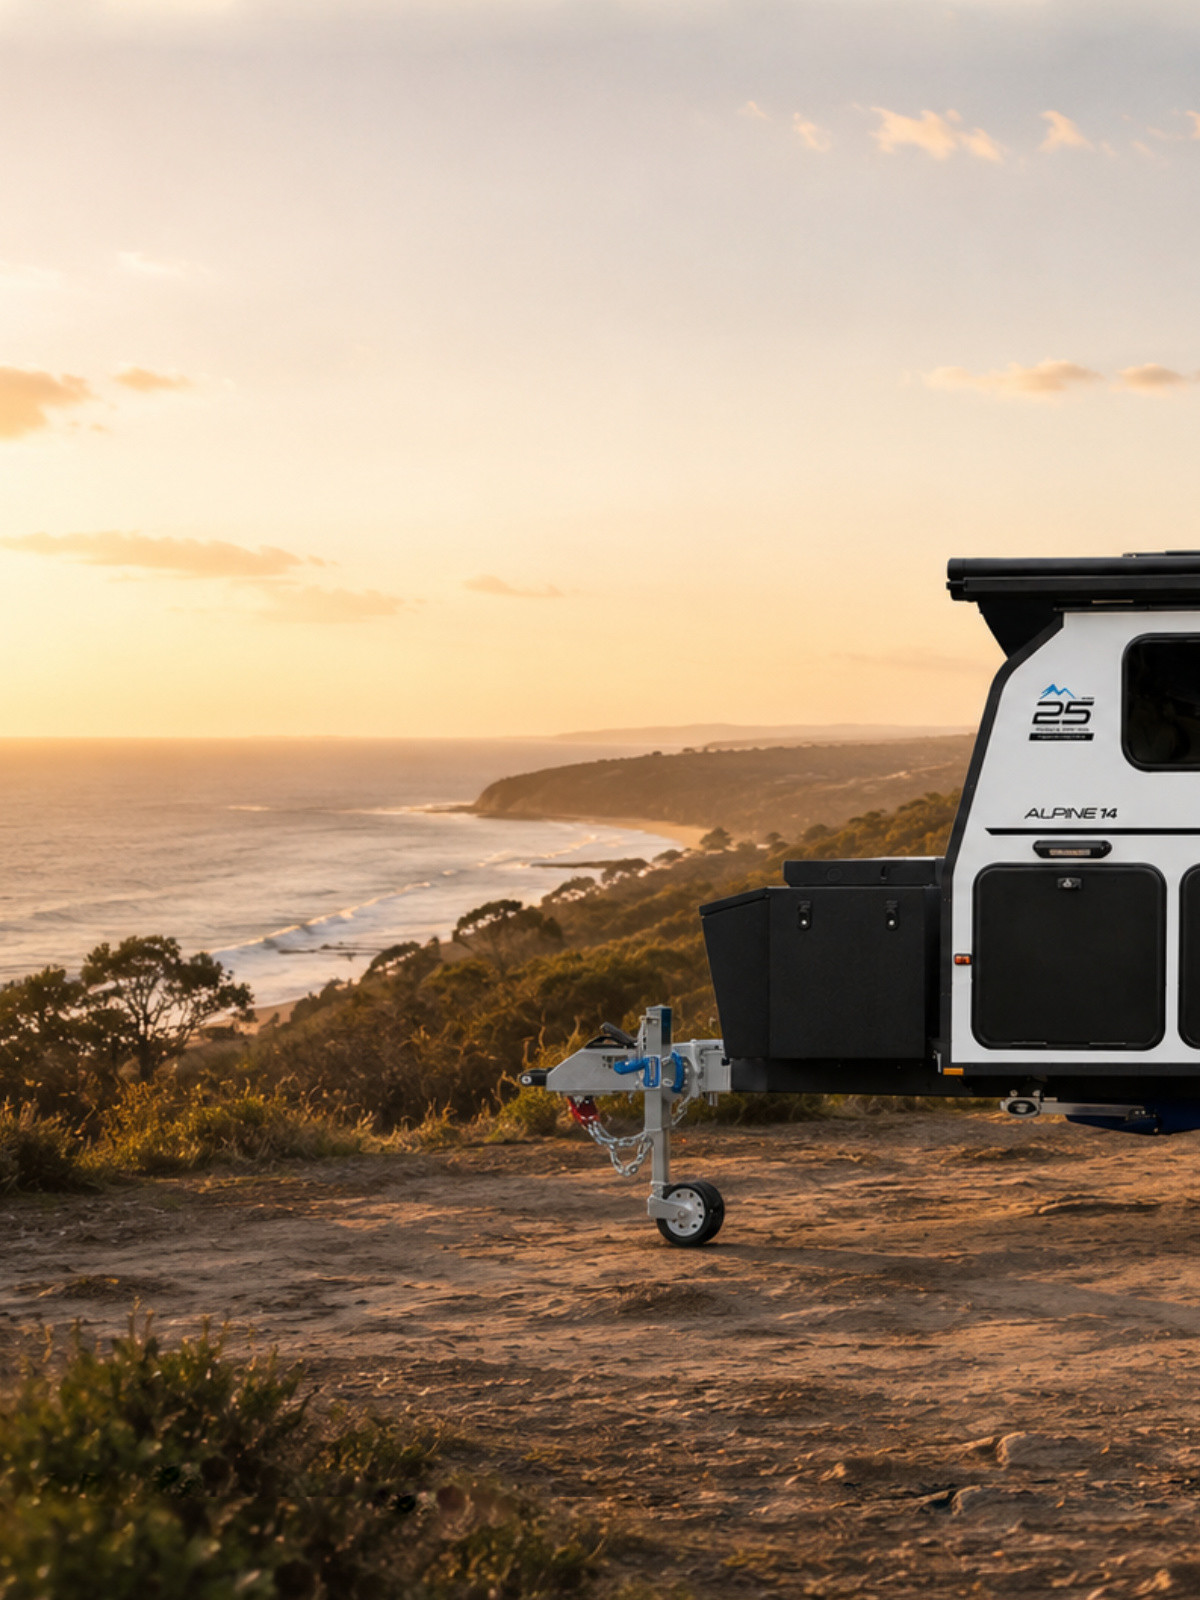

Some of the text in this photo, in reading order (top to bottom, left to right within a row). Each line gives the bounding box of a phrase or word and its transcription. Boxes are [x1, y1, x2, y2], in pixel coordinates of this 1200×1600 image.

[1032, 700, 1094, 724] 25
[1024, 807, 1118, 819] ALPINE 14
